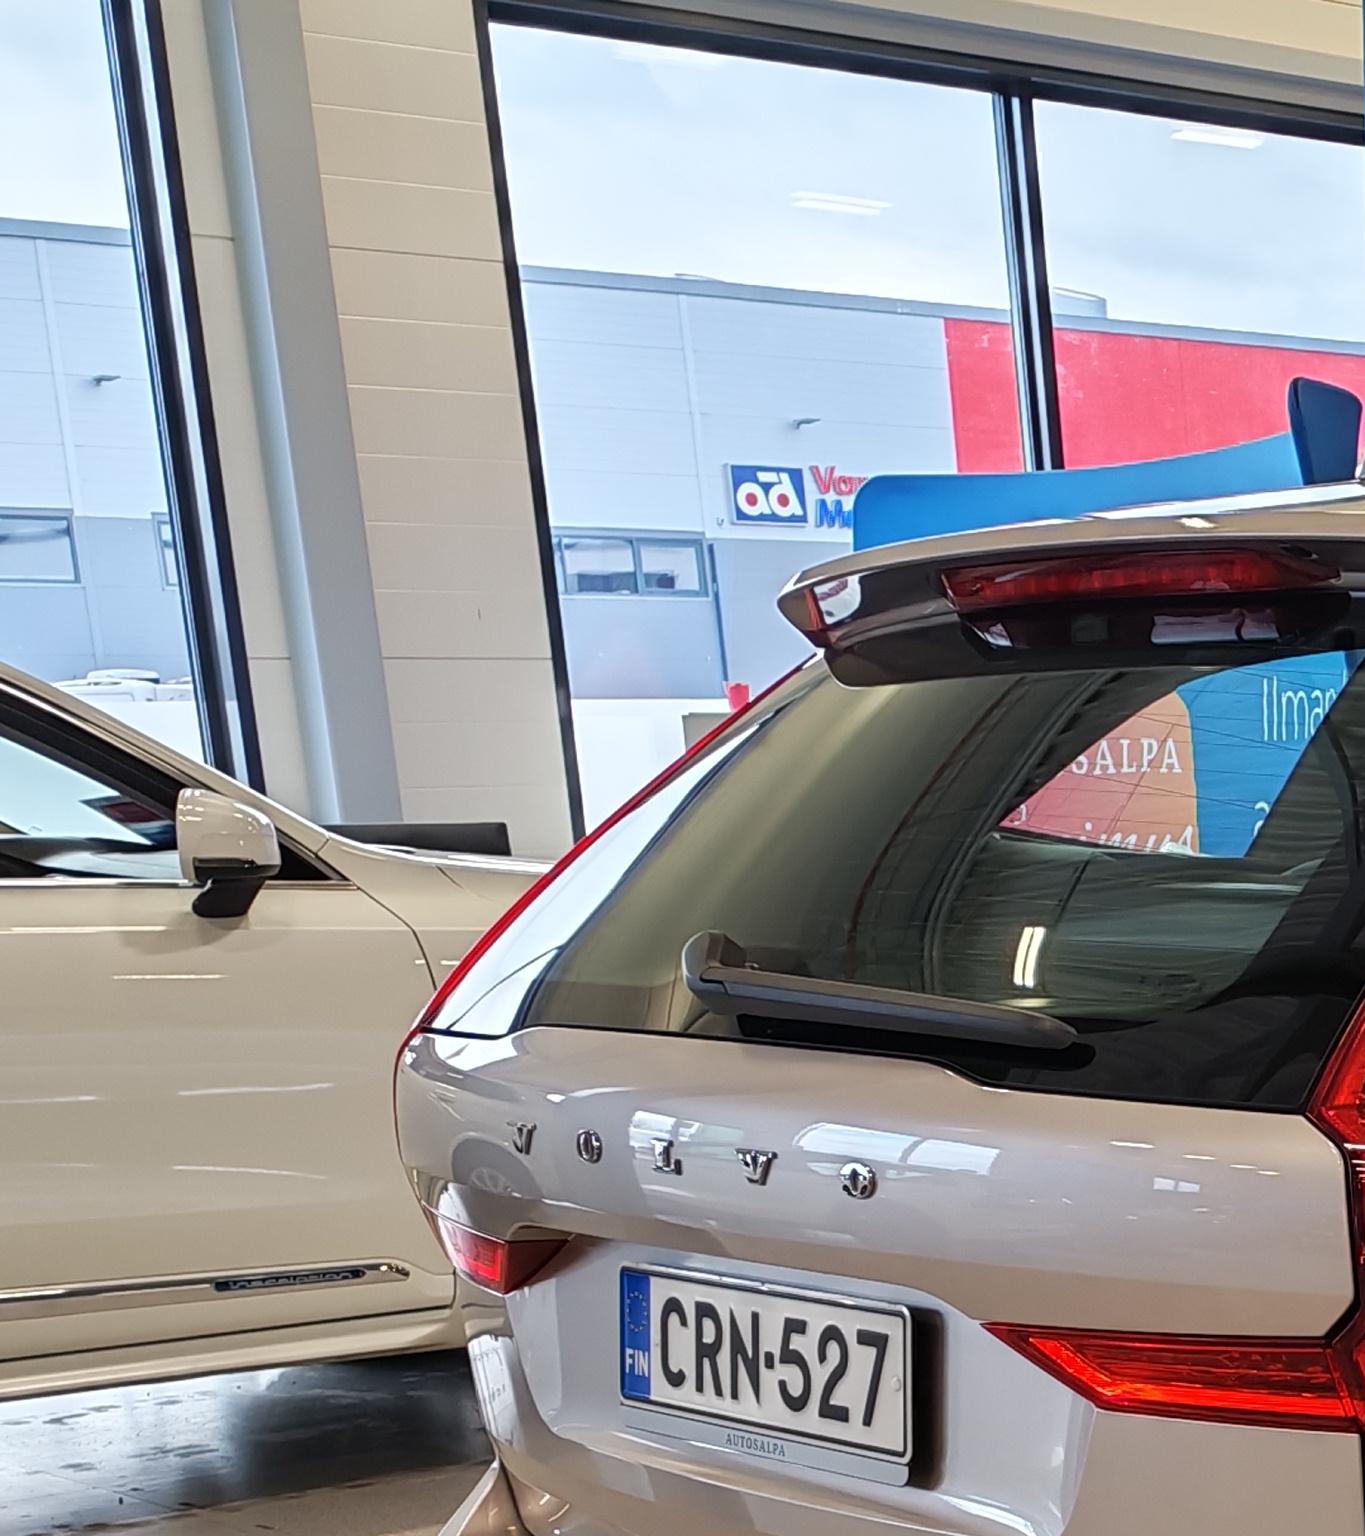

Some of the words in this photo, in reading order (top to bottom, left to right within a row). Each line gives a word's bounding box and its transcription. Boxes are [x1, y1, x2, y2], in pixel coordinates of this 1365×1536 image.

[506, 1120, 878, 1200] VOLVO
[625, 1348, 649, 1378] FIN
[659, 1296, 890, 1428] CRN-527
[725, 1432, 787, 1458] AUTOSALPA
